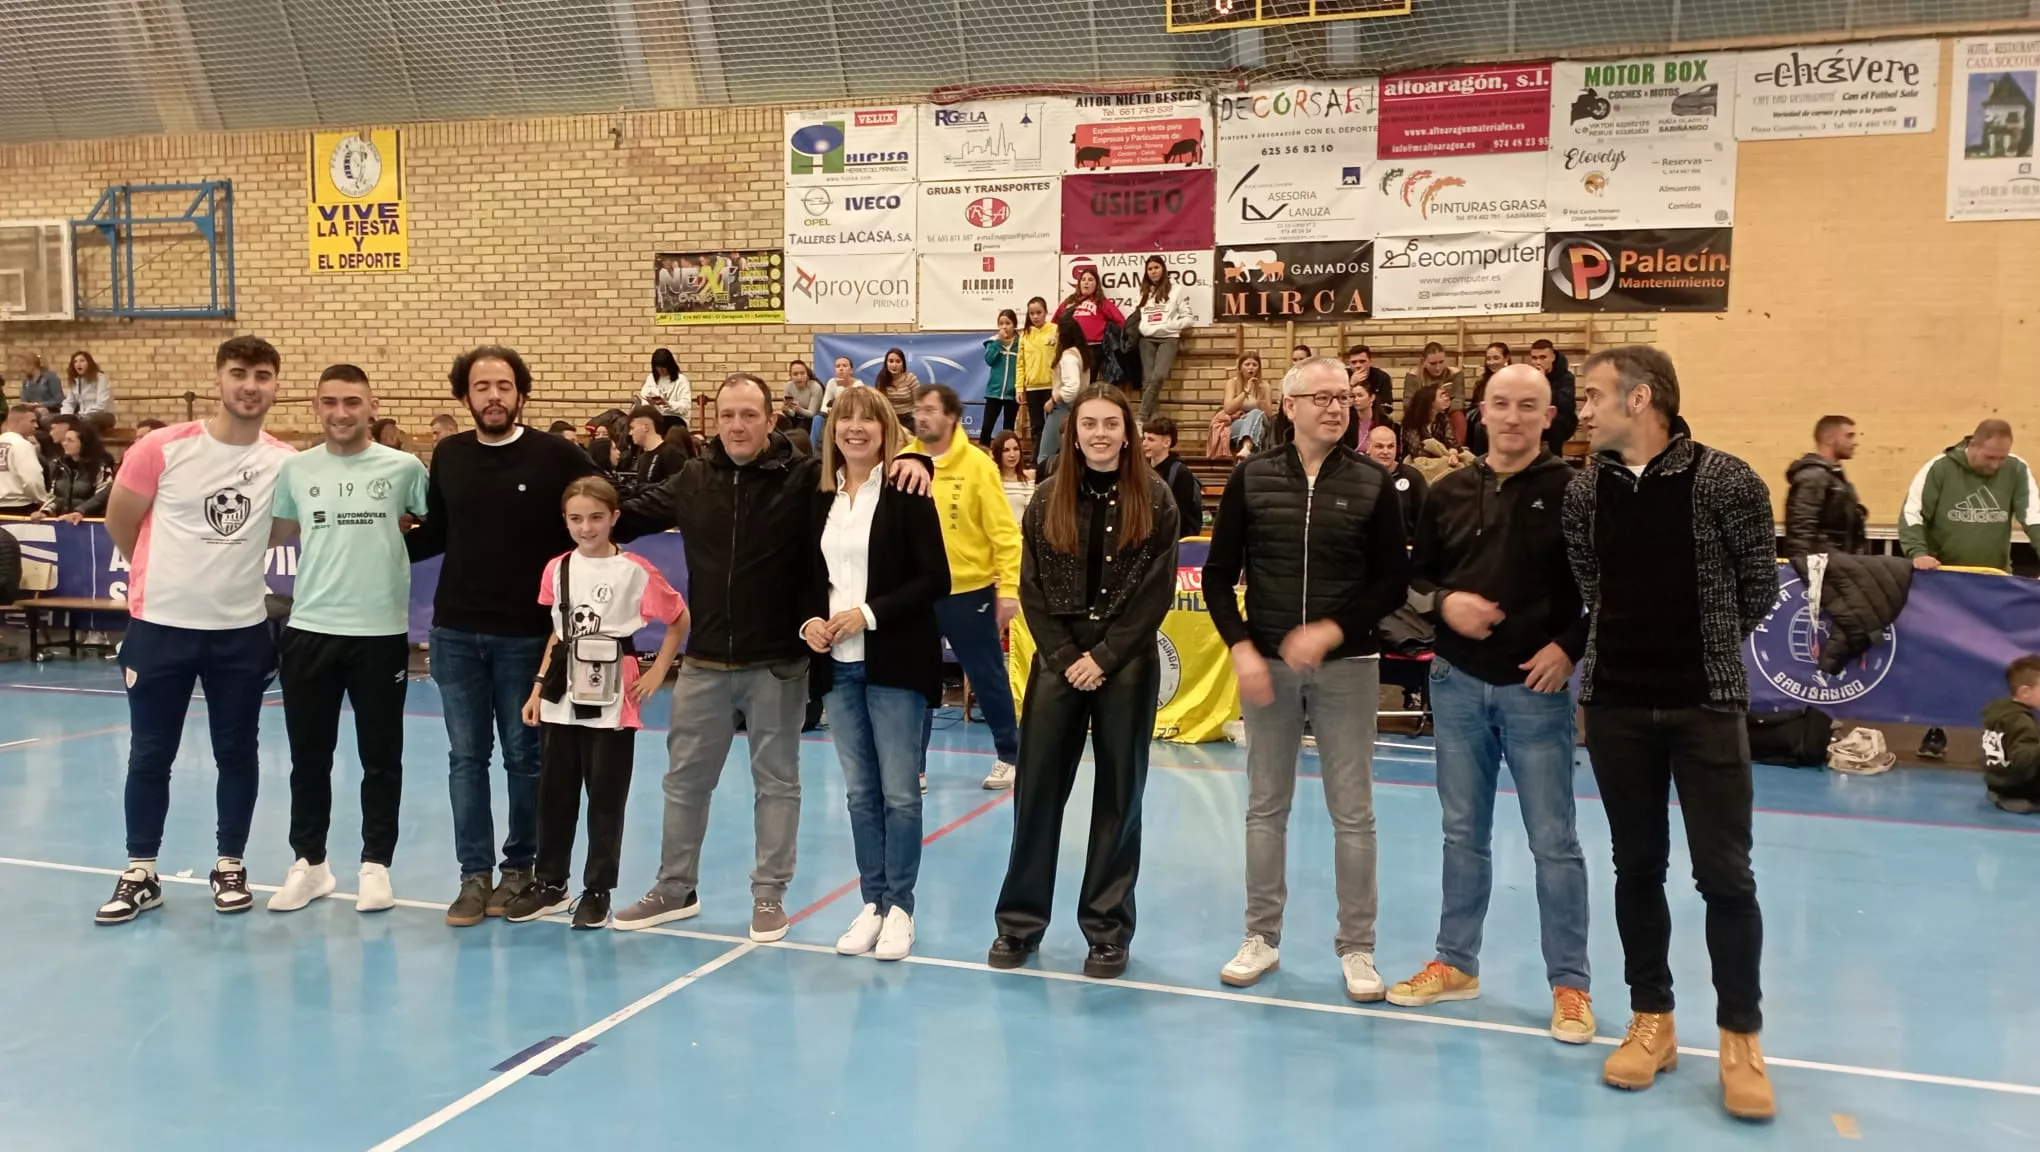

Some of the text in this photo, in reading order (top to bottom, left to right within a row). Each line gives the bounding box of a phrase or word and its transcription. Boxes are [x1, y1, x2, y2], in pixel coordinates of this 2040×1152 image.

[1516, 70, 1550, 88] s.l.
[1584, 60, 1708, 87] MOTOR BOX
[1076, 97, 1111, 107] AITOR
[1116, 93, 1151, 106] NIETO
[1608, 89, 1642, 99] COCHES
[1649, 87, 1680, 98] MOTOS
[1261, 147, 1281, 156] 625
[1320, 144, 1334, 152] 10
[1493, 138, 1509, 148] 974
[846, 151, 909, 163] HIPISA
[1662, 158, 1702, 166] Reservas
[927, 182, 1051, 197] GRUAS Y TRANSPORTES
[1090, 189, 1184, 217] USIETO
[1431, 199, 1547, 214] PINTURAS GRASA
[318, 202, 400, 221] VIVE
[804, 195, 900, 227] OPEL IVECO
[1289, 207, 1331, 217] LANUZA
[317, 220, 401, 237] LA FIESTA
[353, 236, 365, 252] Y
[318, 252, 402, 270] EL DEPORTE
[1419, 243, 1545, 270] ecomputer
[1620, 247, 1728, 273] Palacín
[1291, 262, 1370, 275] GANADOS
[1619, 276, 1726, 289] Mantenimiento
[816, 278, 909, 304] proycon
[1222, 288, 1368, 317] MIRCA
[338, 482, 354, 497] 19
[1947, 509, 2009, 523] adidas
